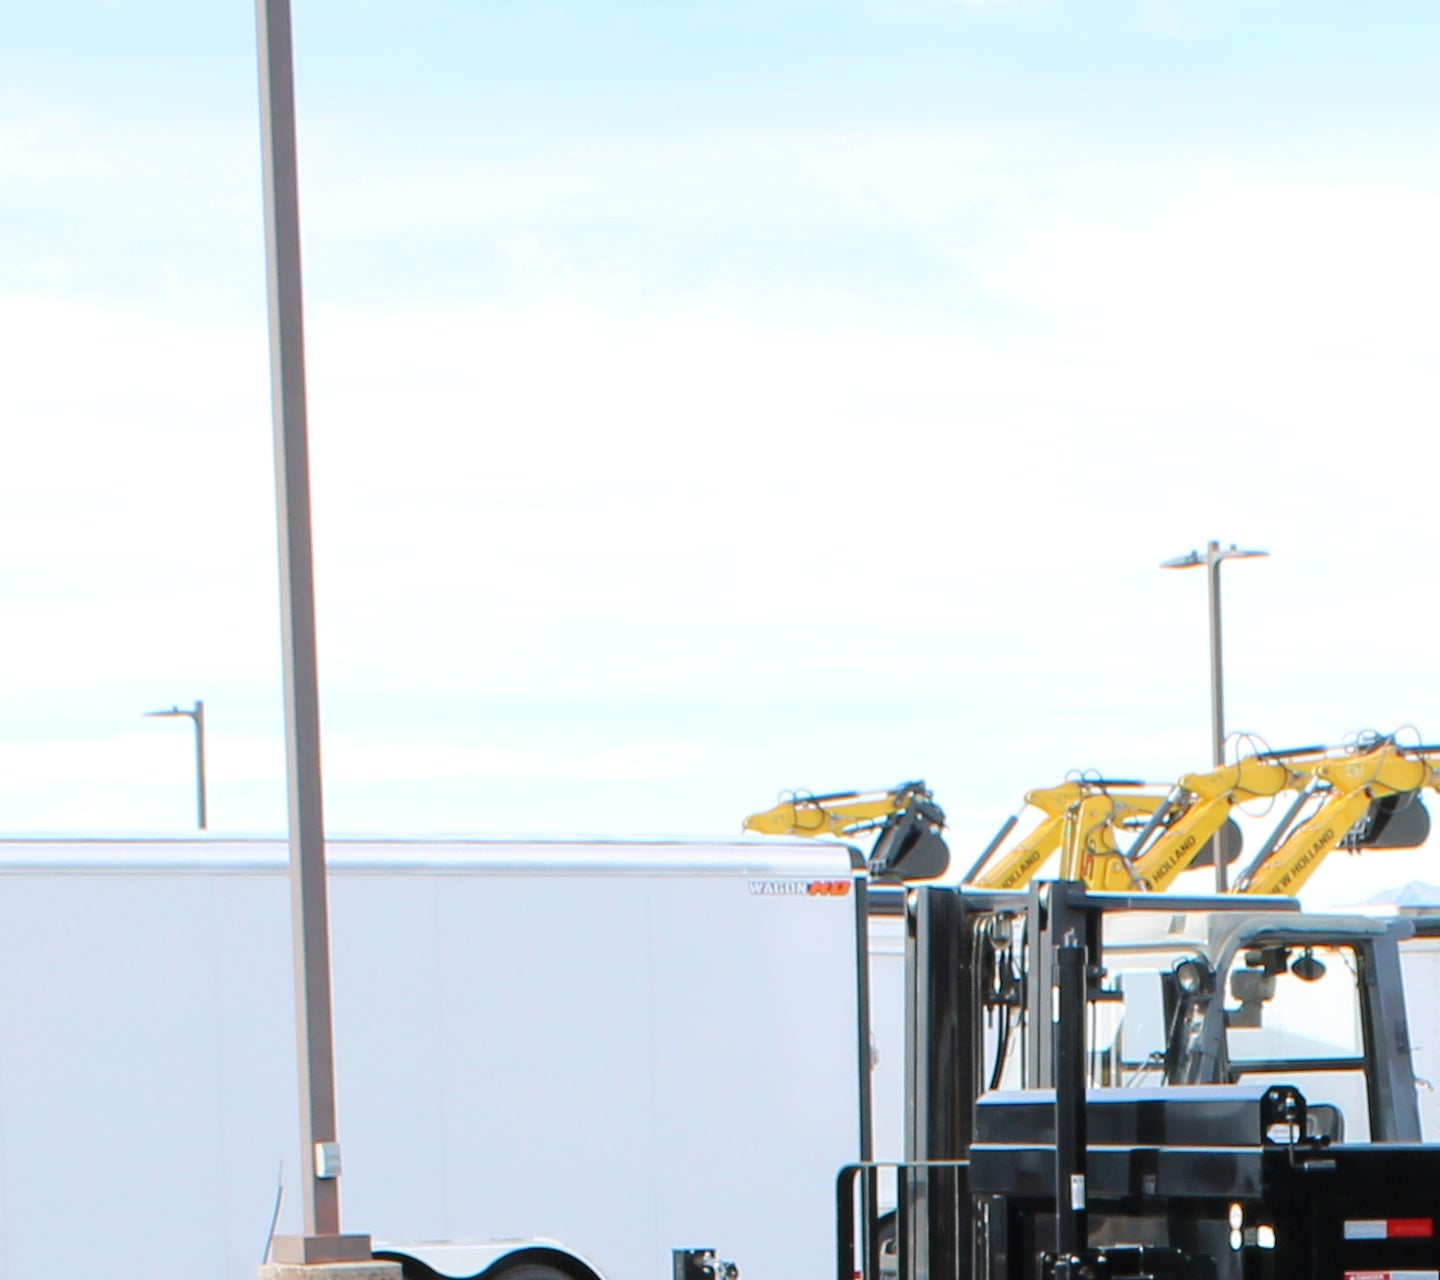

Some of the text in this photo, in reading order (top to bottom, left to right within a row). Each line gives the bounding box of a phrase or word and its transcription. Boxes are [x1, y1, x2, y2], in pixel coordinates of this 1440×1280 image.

[1152, 834, 1196, 884] HOLLAND
[1291, 828, 1335, 877] HOLLAND
[747, 881, 808, 896] WAGON
